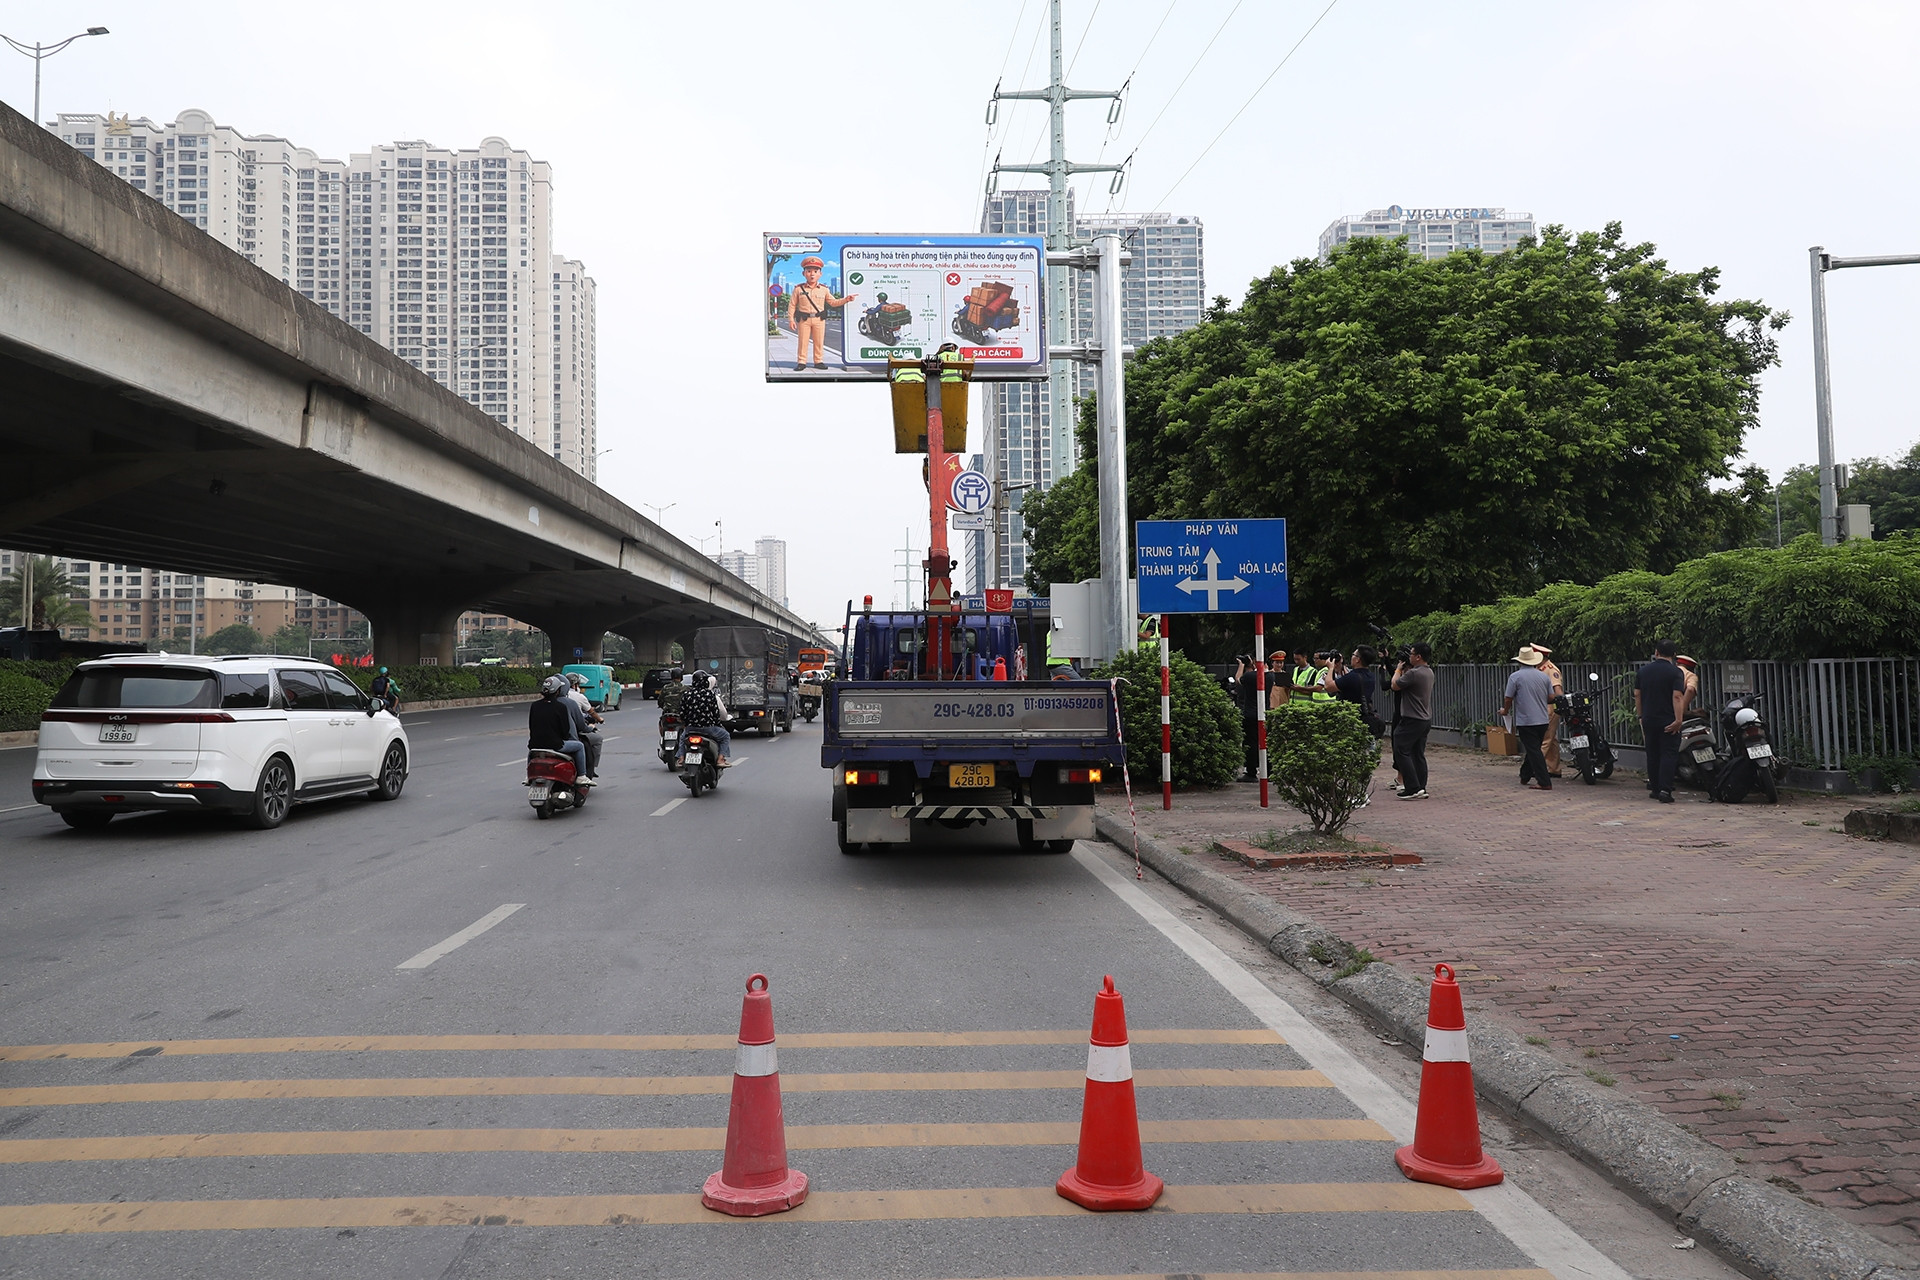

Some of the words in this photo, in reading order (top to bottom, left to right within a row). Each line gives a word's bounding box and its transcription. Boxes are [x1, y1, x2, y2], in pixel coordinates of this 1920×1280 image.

[1407, 208, 1490, 220] VIGLACERA
[846, 250, 860, 260] Chở
[862, 251, 879, 261] hàng
[880, 251, 894, 260] hoá
[895, 251, 910, 260] trên
[911, 252, 938, 261] phương
[939, 252, 952, 260] tiện
[954, 251, 968, 261] phải
[987, 251, 1004, 261] đúng
[1020, 252, 1034, 261] định
[989, 348, 1010, 356] CÁCH
[1186, 522, 1213, 536] PHÁP
[1218, 522, 1238, 535] VÂN
[1140, 546, 1172, 557] TRUNG
[1178, 543, 1200, 557] TÂM
[1140, 562, 1173, 576] THÀNH
[1178, 560, 1198, 575] PHỐ
[1239, 560, 1260, 574] HÒA
[1264, 562, 1285, 576] LẠC
[934, 704, 1015, 718] 29C-428.03
[962, 766, 982, 775] 29C
[955, 776, 990, 787] 428.03
